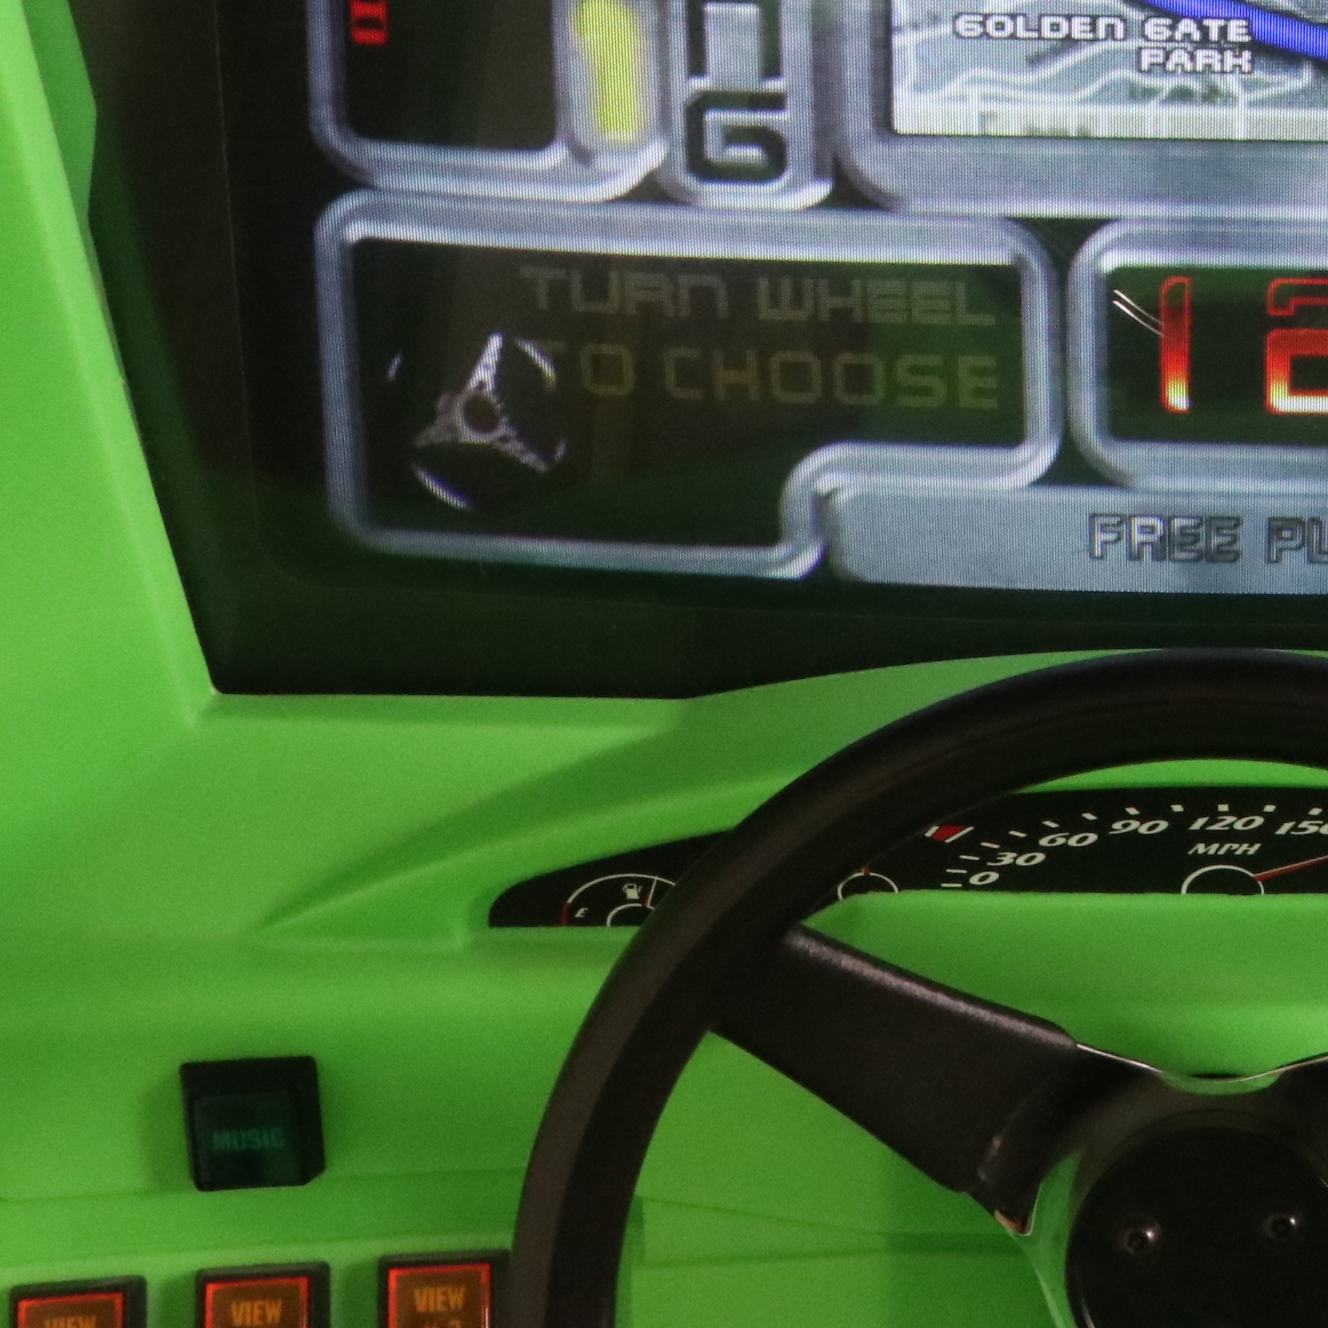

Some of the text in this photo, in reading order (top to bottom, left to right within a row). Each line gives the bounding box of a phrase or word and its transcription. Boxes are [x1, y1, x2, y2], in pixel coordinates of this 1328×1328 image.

[954, 13, 1253, 43] GOLDEN GATE
[1139, 46, 1253, 74] PARK
[520, 266, 996, 328] TURN WHEEL
[664, 348, 999, 410] CHOOSE
[1088, 512, 1243, 563] FREE
[1108, 819, 1170, 836] 90
[1188, 815, 1265, 832] 120
[1037, 832, 1099, 847] 60
[1187, 842, 1262, 856] MPH
[986, 851, 1047, 867] 30
[967, 870, 1000, 886] 0
[211, 1127, 286, 1152] MUSIC
[414, 1285, 466, 1313] VIEW
[230, 1298, 283, 1327] VIEW
